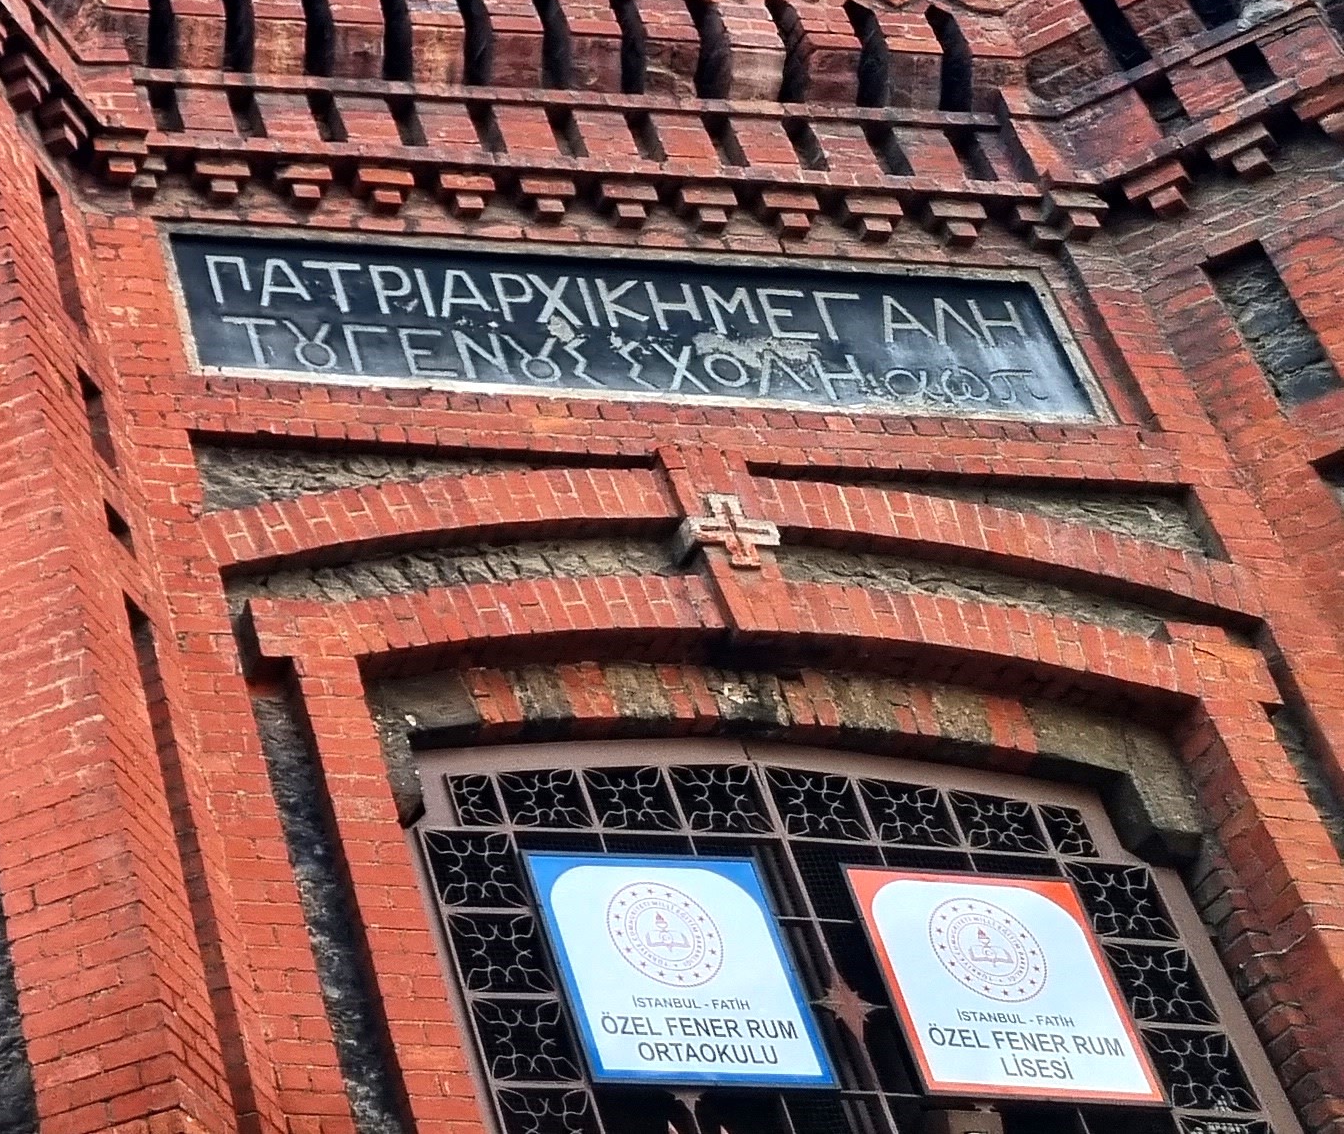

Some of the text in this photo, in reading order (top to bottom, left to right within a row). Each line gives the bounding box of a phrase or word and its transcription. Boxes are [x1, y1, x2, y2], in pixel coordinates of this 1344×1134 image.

[632, 995, 702, 1009] İSTANBUL
[712, 997, 751, 1011] FATİH
[601, 1011, 798, 1040] ÖZEL FENER RUM
[956, 1008, 1026, 1025] İSTANBUL
[1036, 1014, 1075, 1028] FATİH
[928, 1023, 1126, 1058] ÖZEL FENER RUM
[638, 1042, 778, 1065] ORTAOKULU
[1000, 1053, 1074, 1080] LİSESİ
